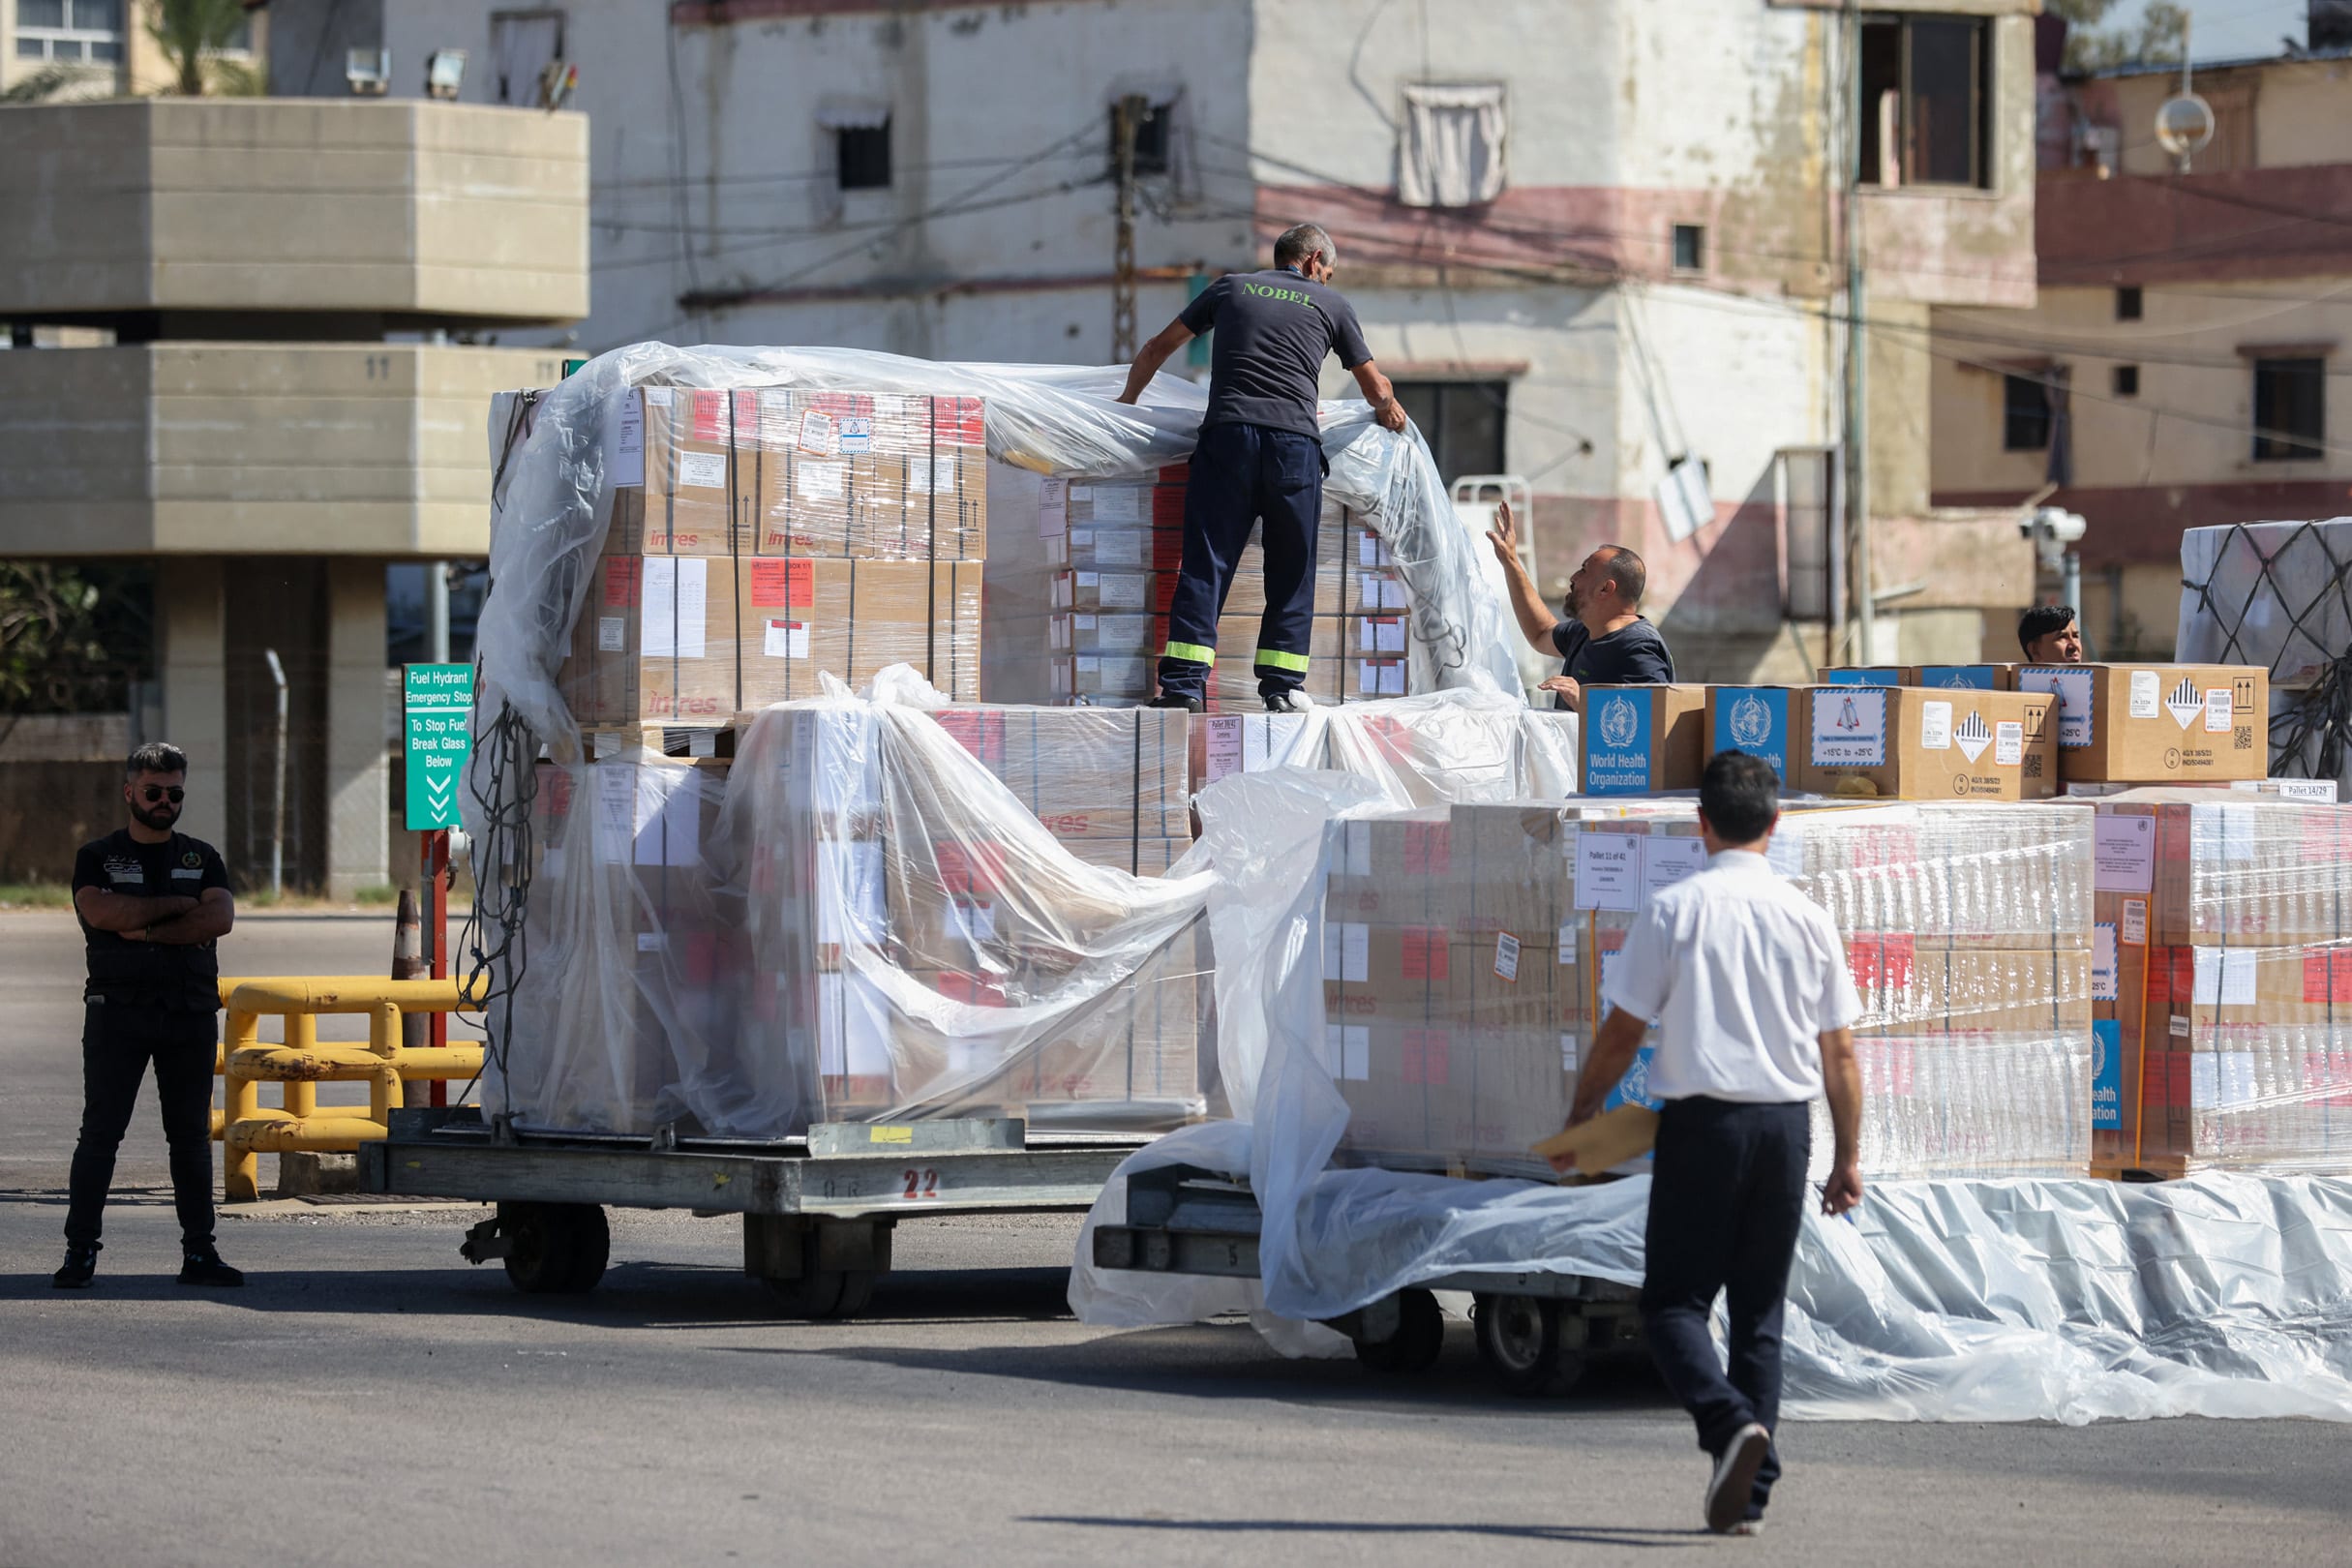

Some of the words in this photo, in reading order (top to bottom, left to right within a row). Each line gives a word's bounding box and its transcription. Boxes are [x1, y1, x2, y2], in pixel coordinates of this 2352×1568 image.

[1242, 282, 1315, 310] NOBEL
[410, 671, 430, 684] Fuel
[433, 671, 468, 687] Hydrant
[406, 691, 451, 706] Emergency
[454, 690, 473, 705] Stop
[411, 719, 423, 732] To
[426, 718, 446, 734] Stop
[412, 737, 438, 750] Break
[441, 737, 467, 750] Glass
[426, 754, 453, 768] Below
[1590, 752, 1616, 768] World
[1617, 752, 1646, 769] Health
[1589, 770, 1646, 790] Organization
[2288, 785, 2307, 795] Pallet
[2308, 785, 2328, 796] 14/29
[2093, 1086, 2117, 1101] ealth
[903, 1167, 939, 1199] 22
